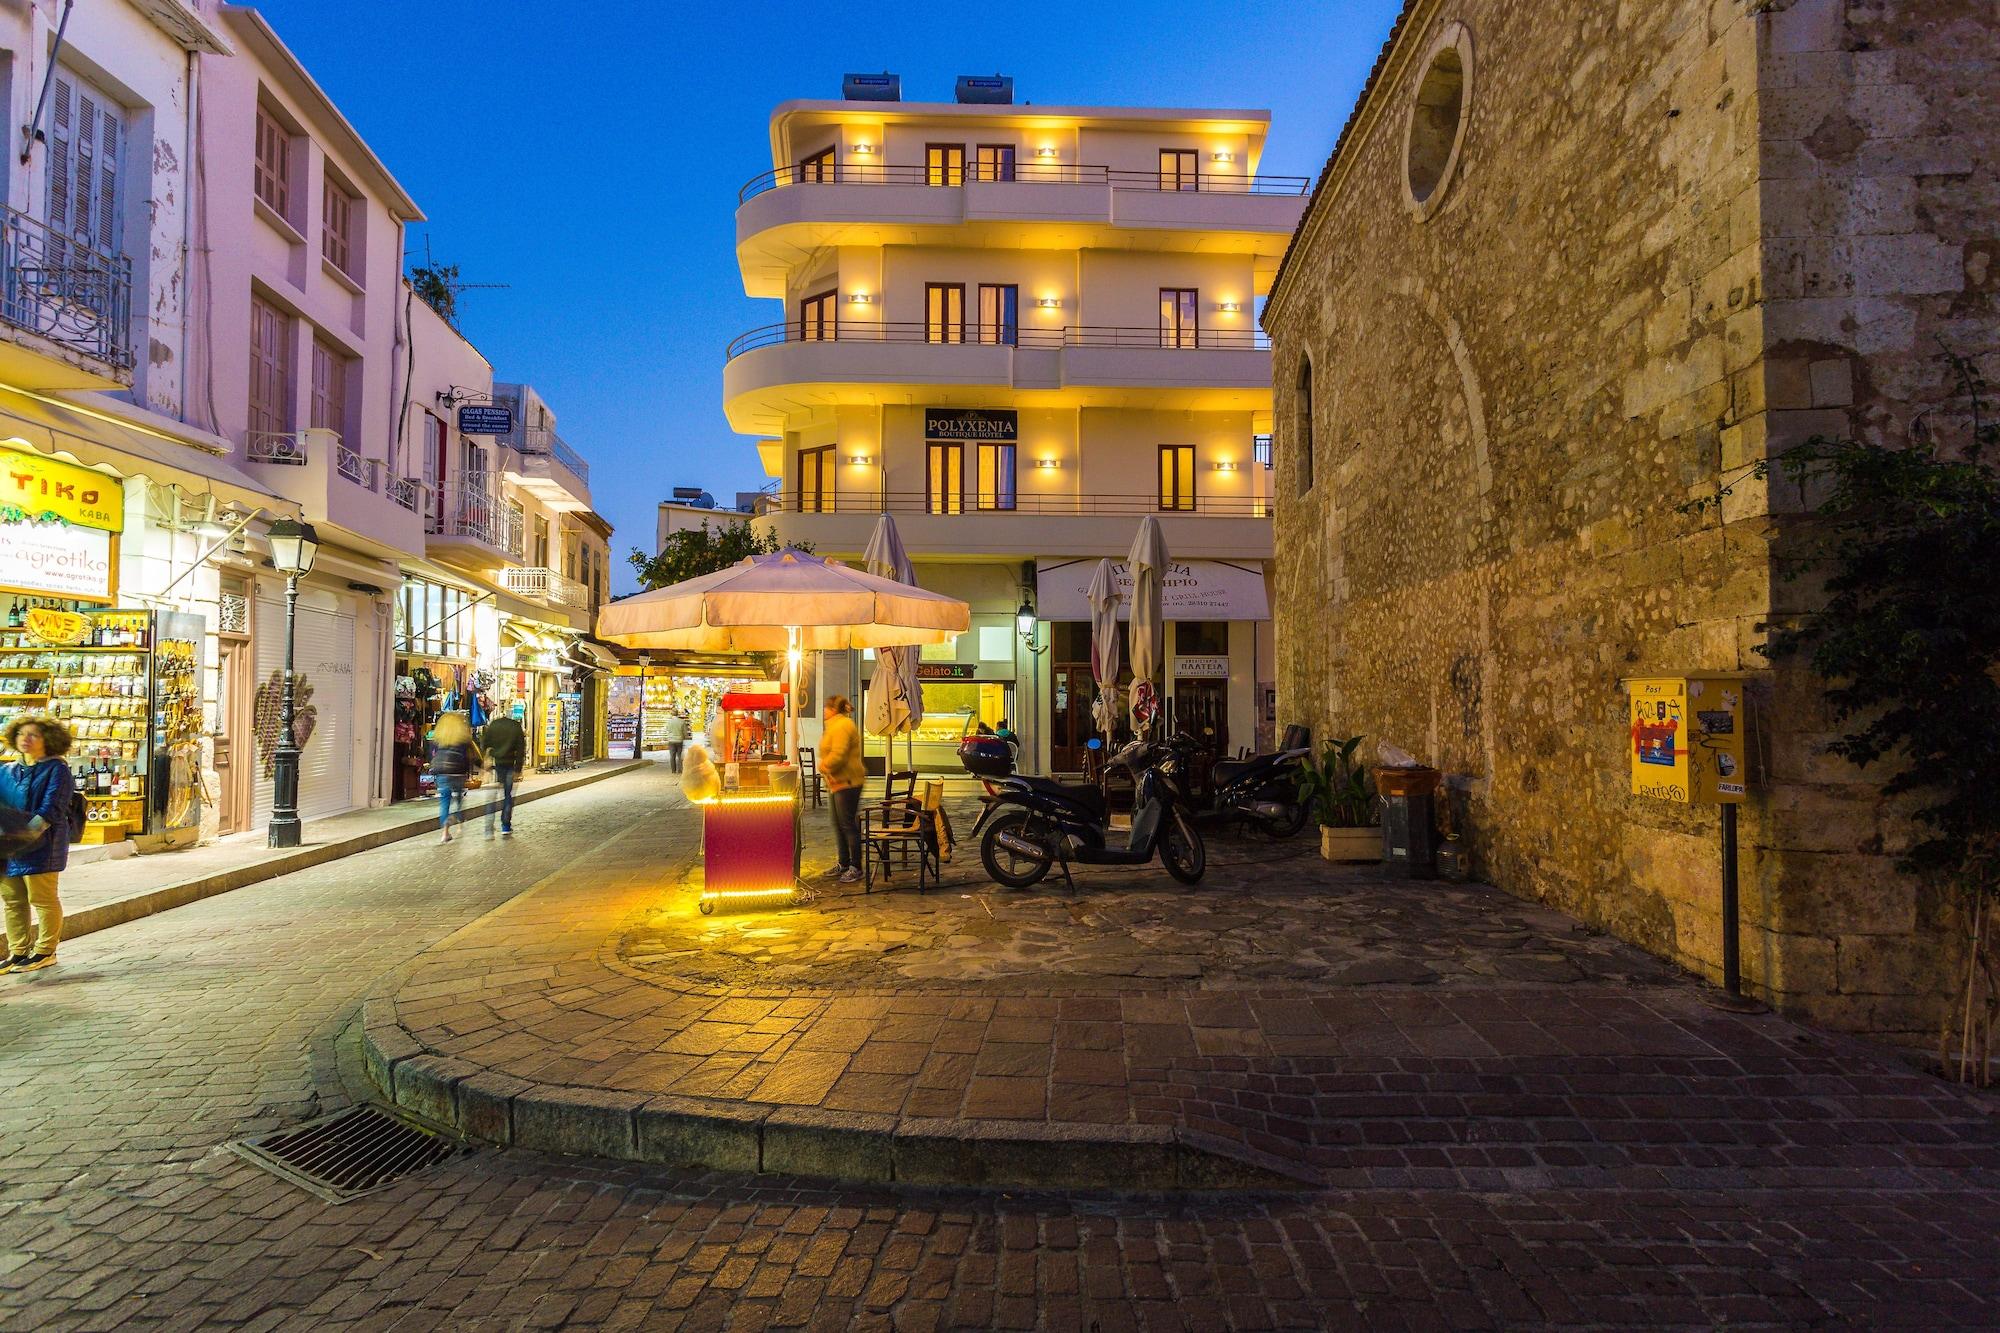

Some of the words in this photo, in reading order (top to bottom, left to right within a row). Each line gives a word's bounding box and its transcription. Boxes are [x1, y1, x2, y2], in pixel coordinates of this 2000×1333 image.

[484, 408, 509, 416] PENSION
[928, 420, 1014, 433] POLYXENIA
[15, 549, 108, 570] agrotiko
